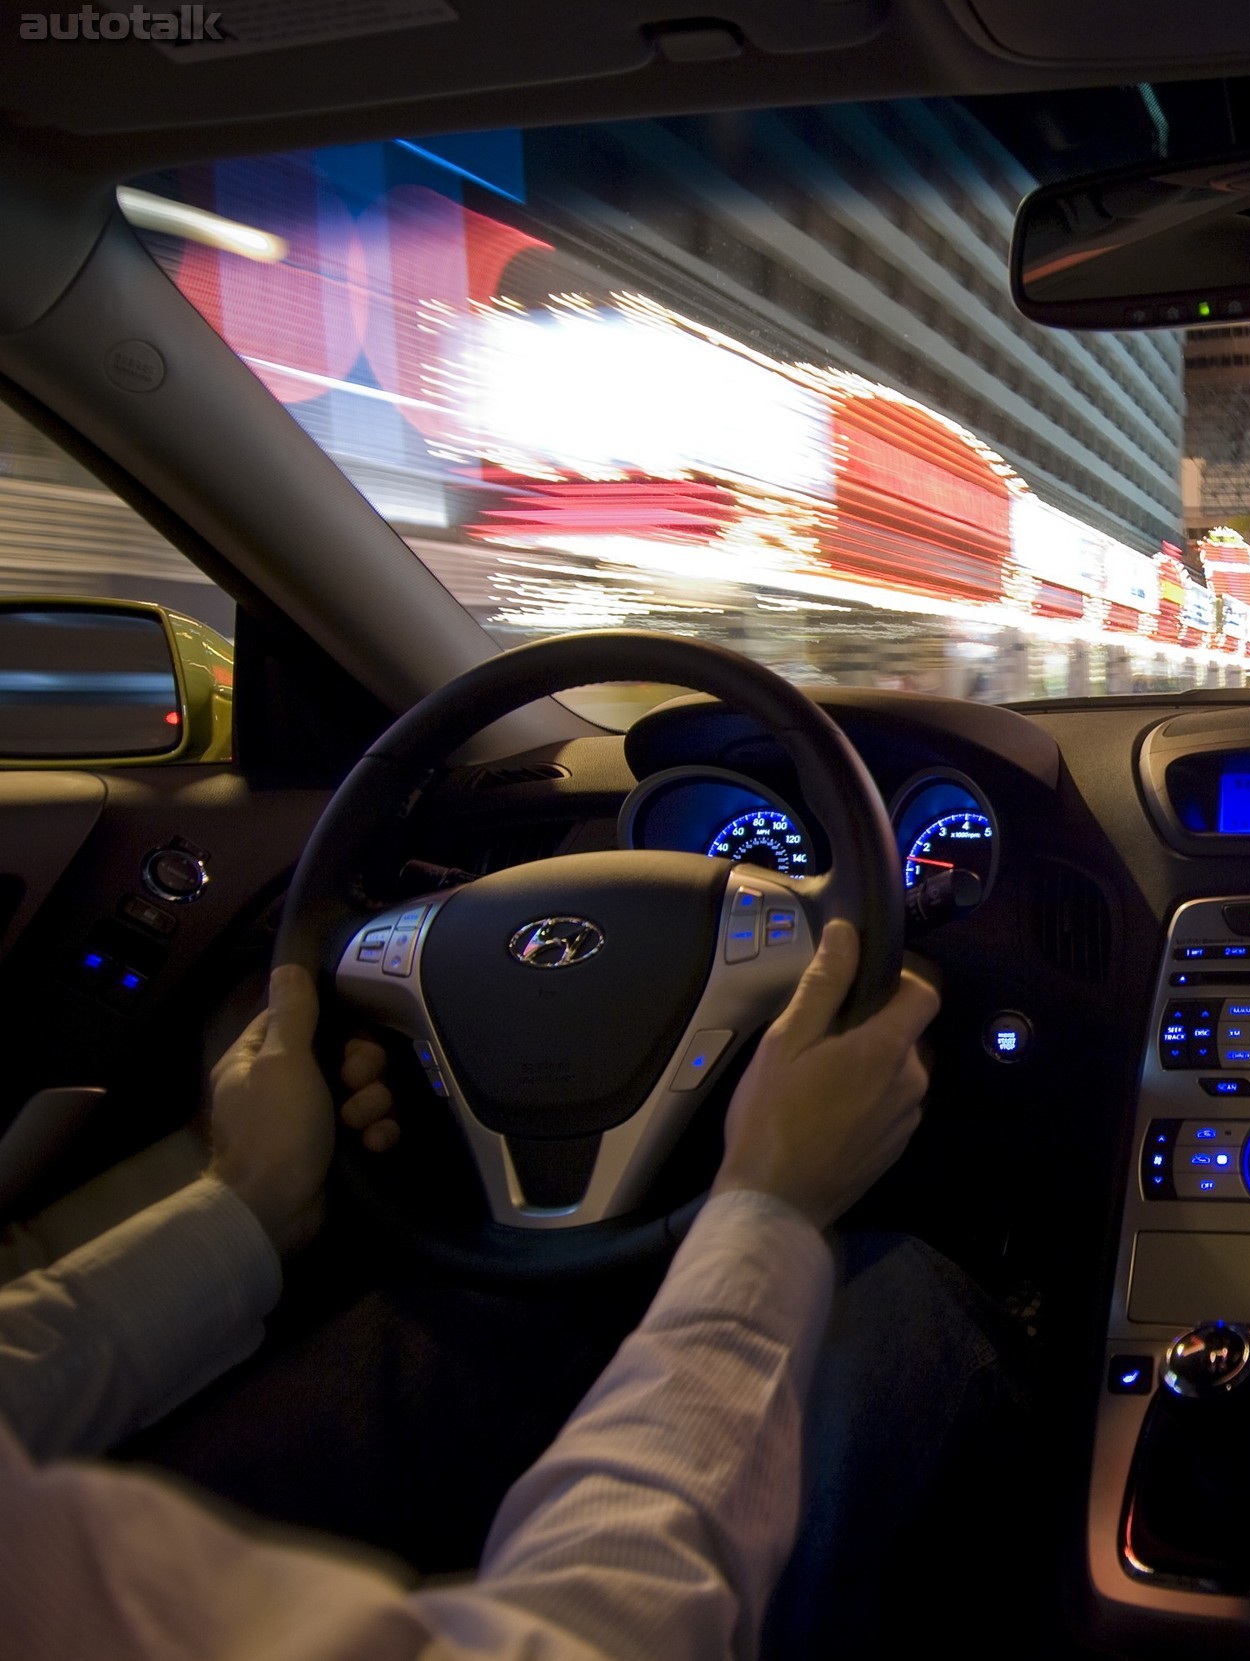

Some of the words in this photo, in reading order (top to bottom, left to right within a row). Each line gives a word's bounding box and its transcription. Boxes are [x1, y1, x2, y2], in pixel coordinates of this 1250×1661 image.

[753, 818, 765, 826] 80
[773, 821, 787, 830] 100
[961, 821, 970, 831] 4
[732, 827, 744, 835] 60
[938, 827, 947, 837] 3
[984, 827, 993, 837] 5
[786, 835, 801, 843] 120
[717, 843, 729, 852] 40
[922, 842, 931, 853] 2
[914, 865, 920, 875] 1
[1164, 1033, 1186, 1041] TRACK
[1194, 1029, 1210, 1037] DISC
[1217, 1083, 1237, 1092] SCAN
[1200, 1181, 1214, 1190] OFF
